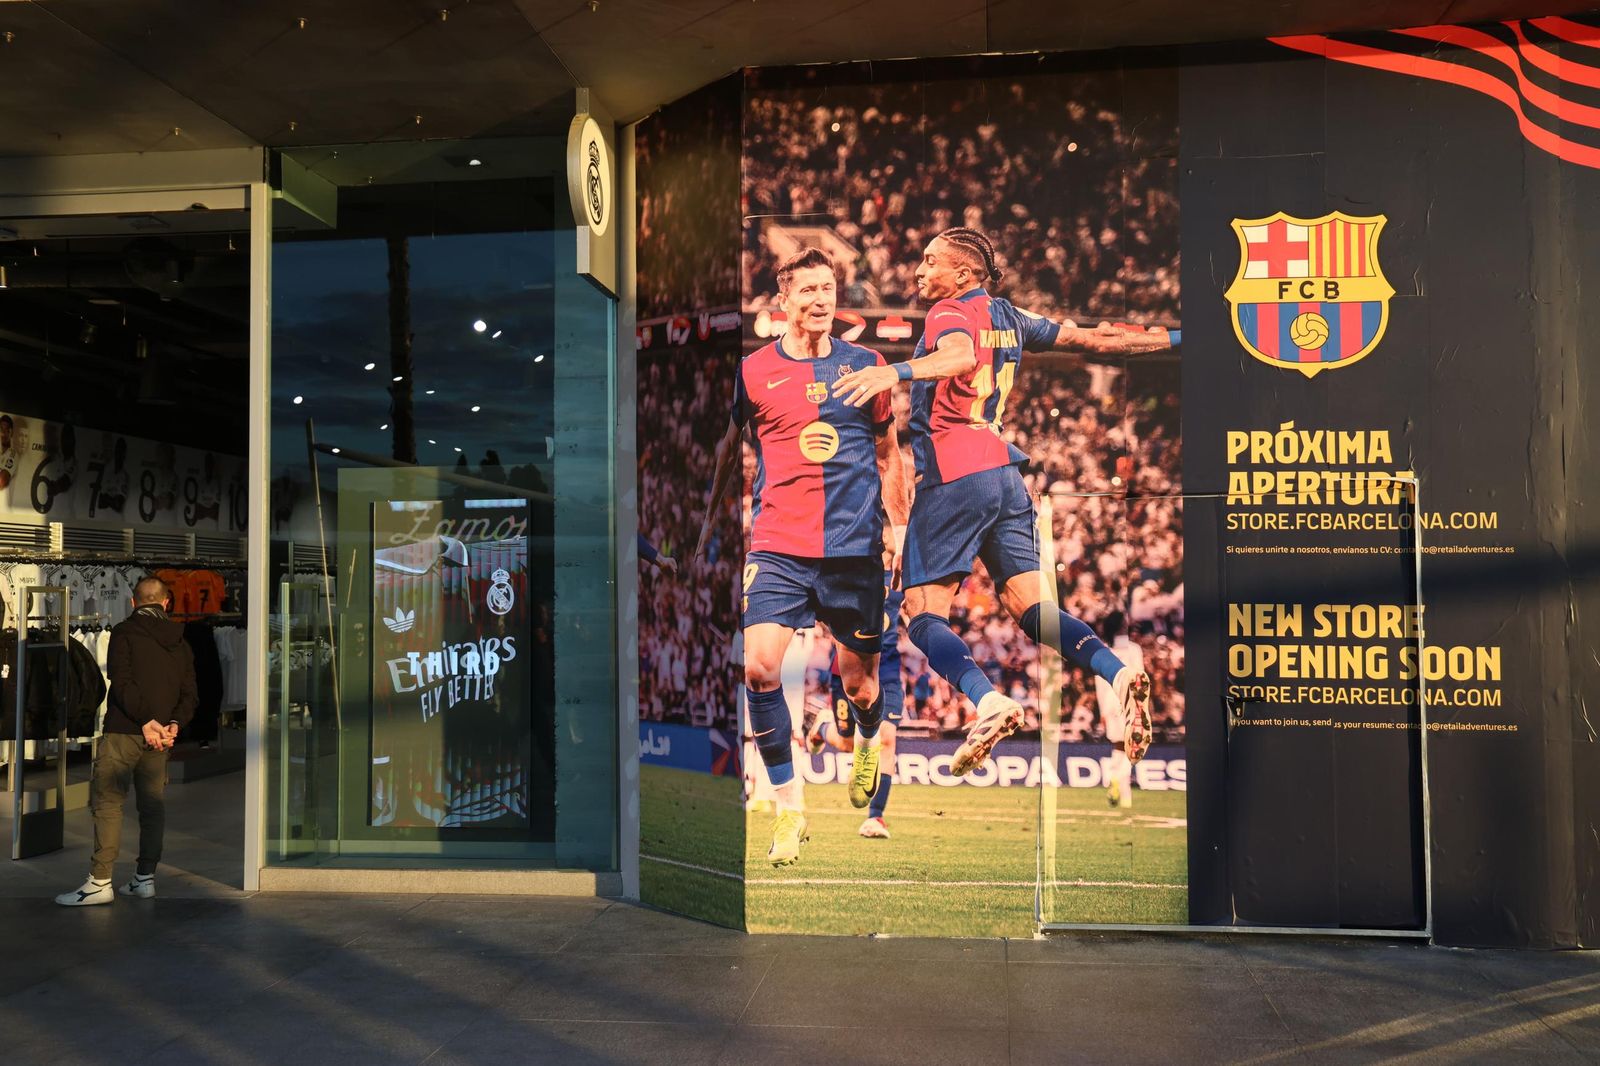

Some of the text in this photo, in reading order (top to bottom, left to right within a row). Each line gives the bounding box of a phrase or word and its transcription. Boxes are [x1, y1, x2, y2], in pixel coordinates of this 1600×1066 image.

[1278, 281, 1340, 299] FCB
[1226, 420, 1393, 465] PRÓXIMA
[1226, 470, 1415, 506] APERTURA
[1226, 511, 1498, 530] STORE.FCBARCELONA.COM
[1226, 545, 1234, 554] Si
[1235, 545, 1264, 555] quieres
[1265, 545, 1289, 554] unirte
[1296, 546, 1332, 555] nosotros,
[1333, 545, 1369, 554] envíanos
[1370, 546, 1379, 554] tu
[1380, 546, 1393, 554] CV:
[1228, 603, 1426, 639] NEW STORE
[407, 651, 500, 676] THIRD
[1228, 644, 1502, 681] OPENING SOON
[421, 685, 443, 723] FLY
[1237, 719, 1251, 727] you
[1252, 718, 1273, 726] want
[1274, 718, 1282, 726] to
[1283, 718, 1298, 727] join
[1300, 719, 1312, 727] us,
[1312, 718, 1332, 726] send
[1343, 721, 1361, 730] your
[1362, 722, 1394, 730] resume:
